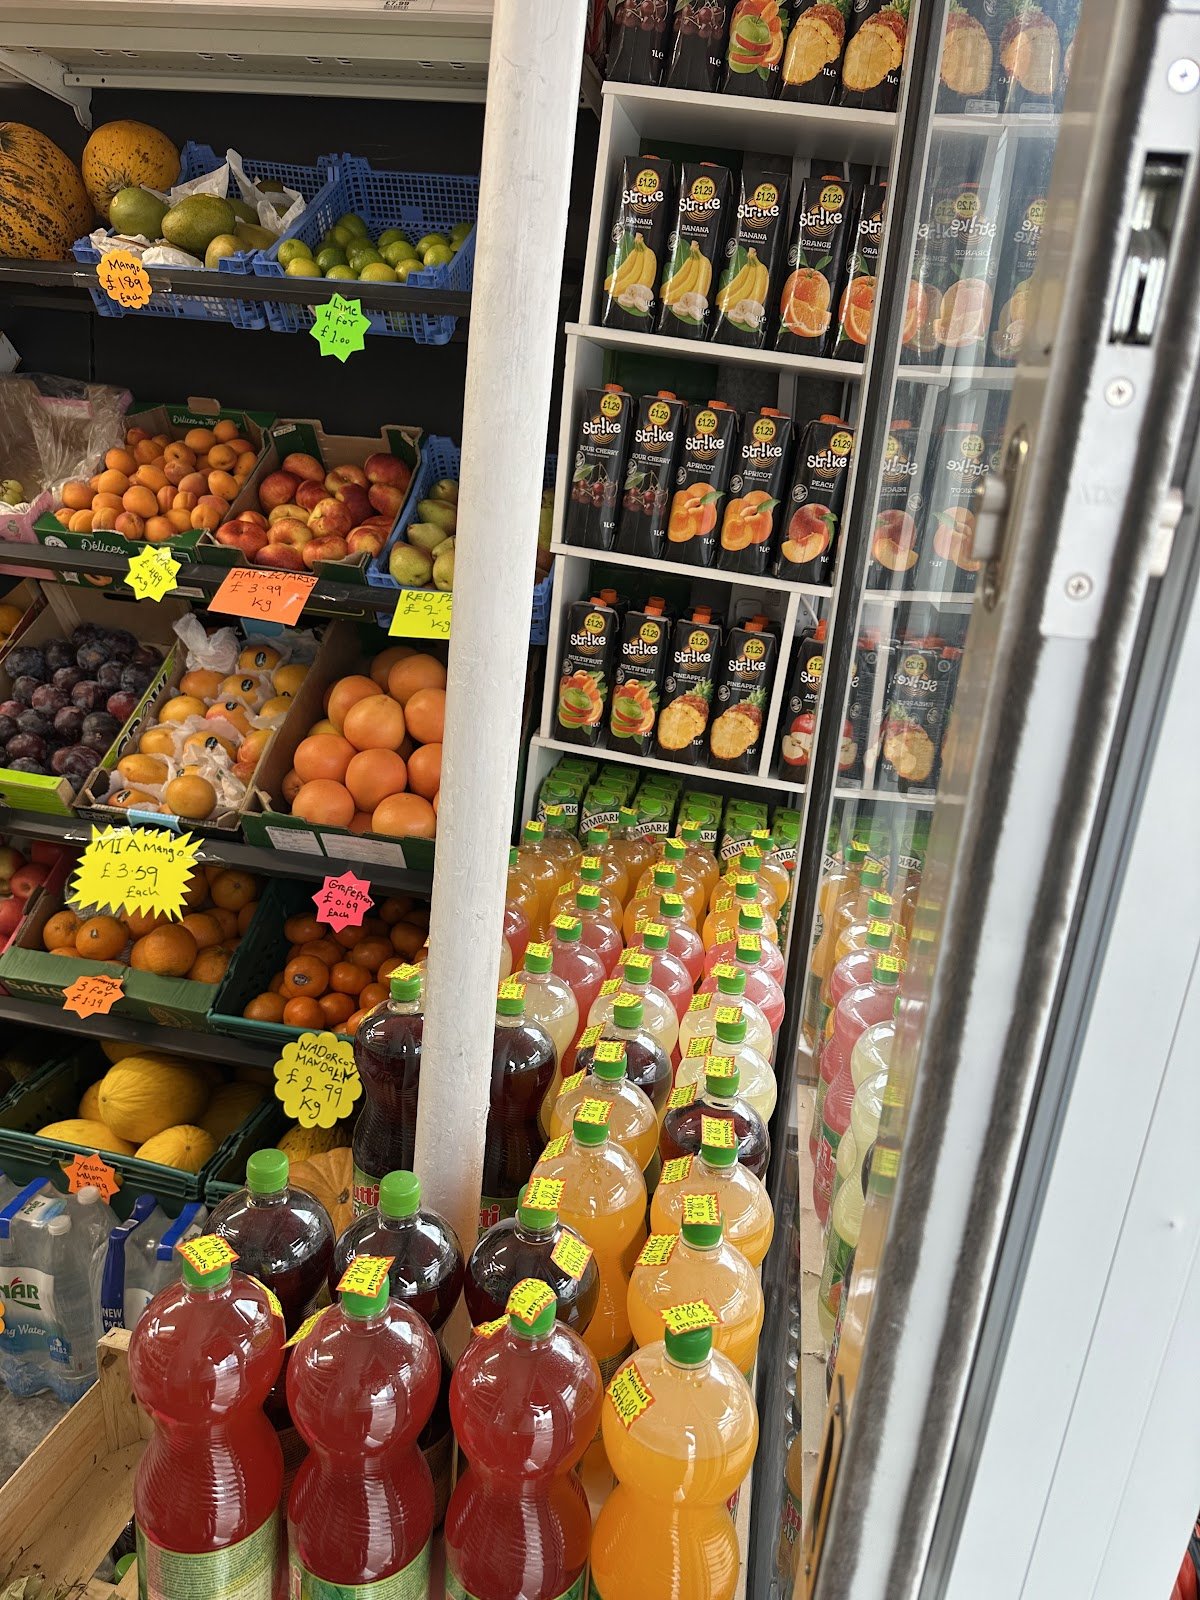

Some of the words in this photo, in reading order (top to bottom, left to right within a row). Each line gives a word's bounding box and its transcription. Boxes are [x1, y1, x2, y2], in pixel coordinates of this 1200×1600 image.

[638, 178, 657, 188] £1.29
[694, 185, 713, 196] £1.29
[756, 192, 776, 203] £1.29
[822, 193, 842, 204] £1.29
[625, 217, 653, 226] BANANA
[681, 224, 709, 234] BANANA
[739, 231, 767, 241] BANANA
[802, 239, 832, 249] ORANGE
[862, 247, 878, 255] ORA
[107, 259, 141, 276] Mango
[325, 310, 331, 321] 4
[602, 401, 620, 411] £1.29
[650, 408, 669, 419] £1.29
[697, 417, 716, 427] £1.29
[755, 426, 773, 436] £1.29
[832, 438, 851, 449] £1.29
[580, 444, 594, 453] SOUR
[595, 446, 619, 456] CHERRY
[632, 452, 647, 461] SOUR
[647, 455, 671, 464] CHERRY
[686, 461, 715, 472] APRICOT
[743, 469, 772, 479] APRICOT
[811, 480, 834, 489] PEACH
[406, 591, 435, 602] RED
[586, 619, 604, 629] £1.29
[641, 628, 659, 639] £1.29
[690, 637, 708, 647] £1.29
[745, 646, 763, 655] £1.29
[568, 653, 603, 665] MULTIFRUIT
[620, 663, 656, 675] MULTIFRUIT
[808, 661, 822, 671] £1.2
[672, 672, 706, 682] PINEAPPLE
[726, 680, 761, 691] PINEAPPLE
[143, 843, 184, 862] Mango
[77, 981, 89, 992] 3
[102, 1308, 123, 1319] NEW
[17, 1324, 46, 1336] Water
[625, 1367, 649, 1403] Special
